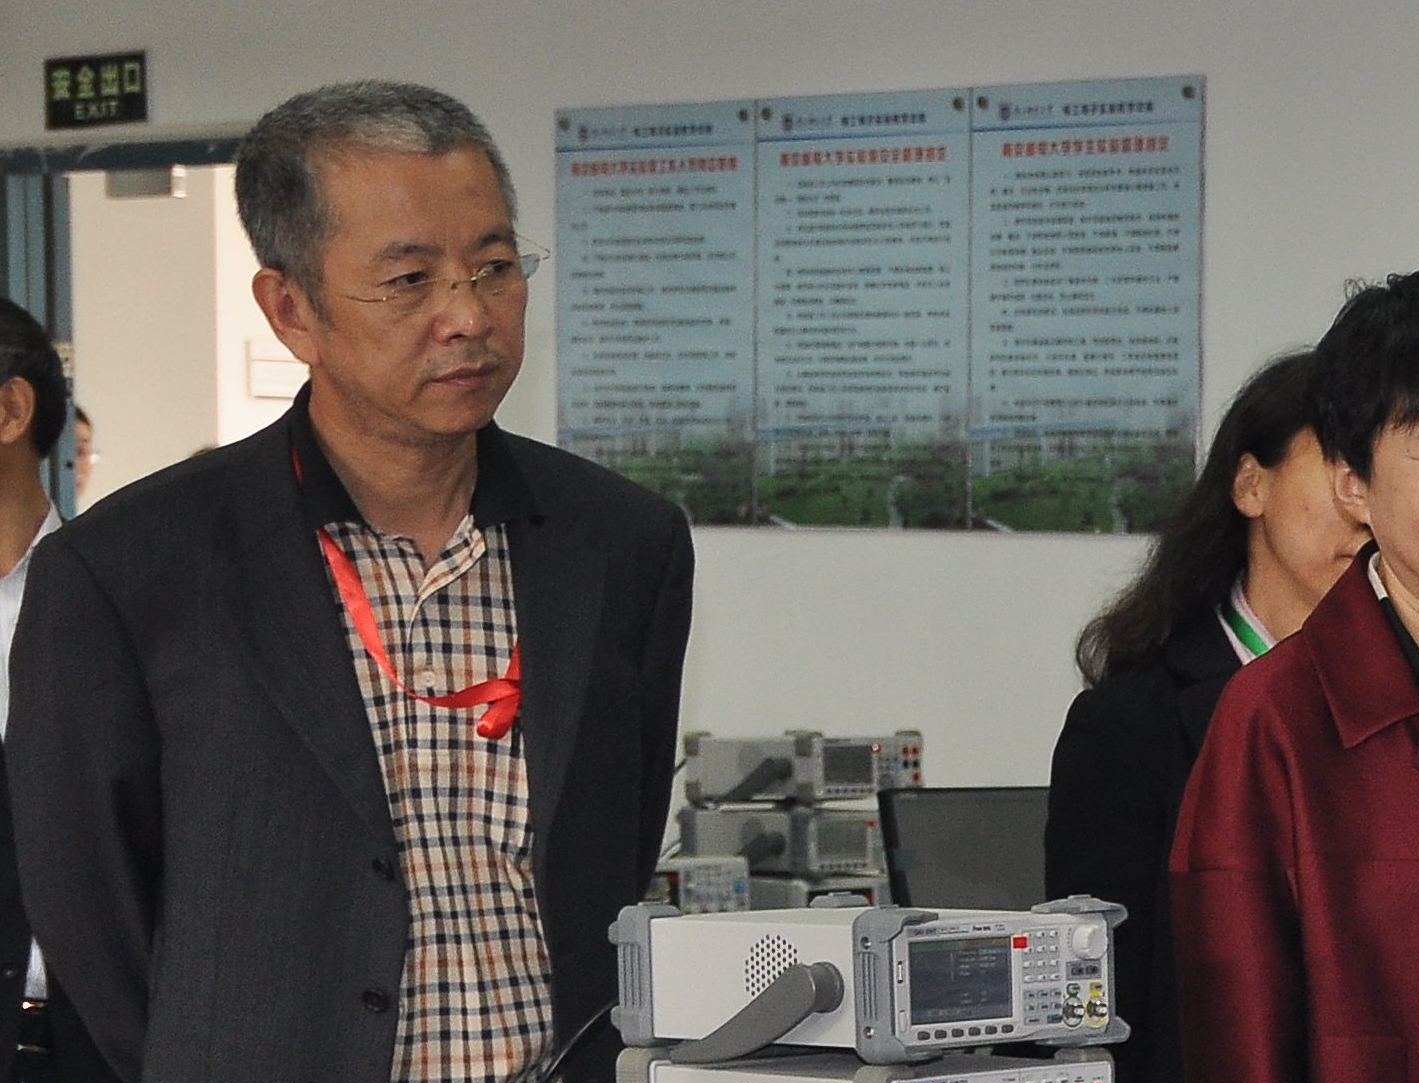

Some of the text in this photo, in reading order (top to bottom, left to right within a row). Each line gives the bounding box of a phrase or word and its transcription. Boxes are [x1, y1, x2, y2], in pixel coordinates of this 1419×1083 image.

[51, 61, 140, 100] 安全出口
[74, 101, 119, 119] EXIT
